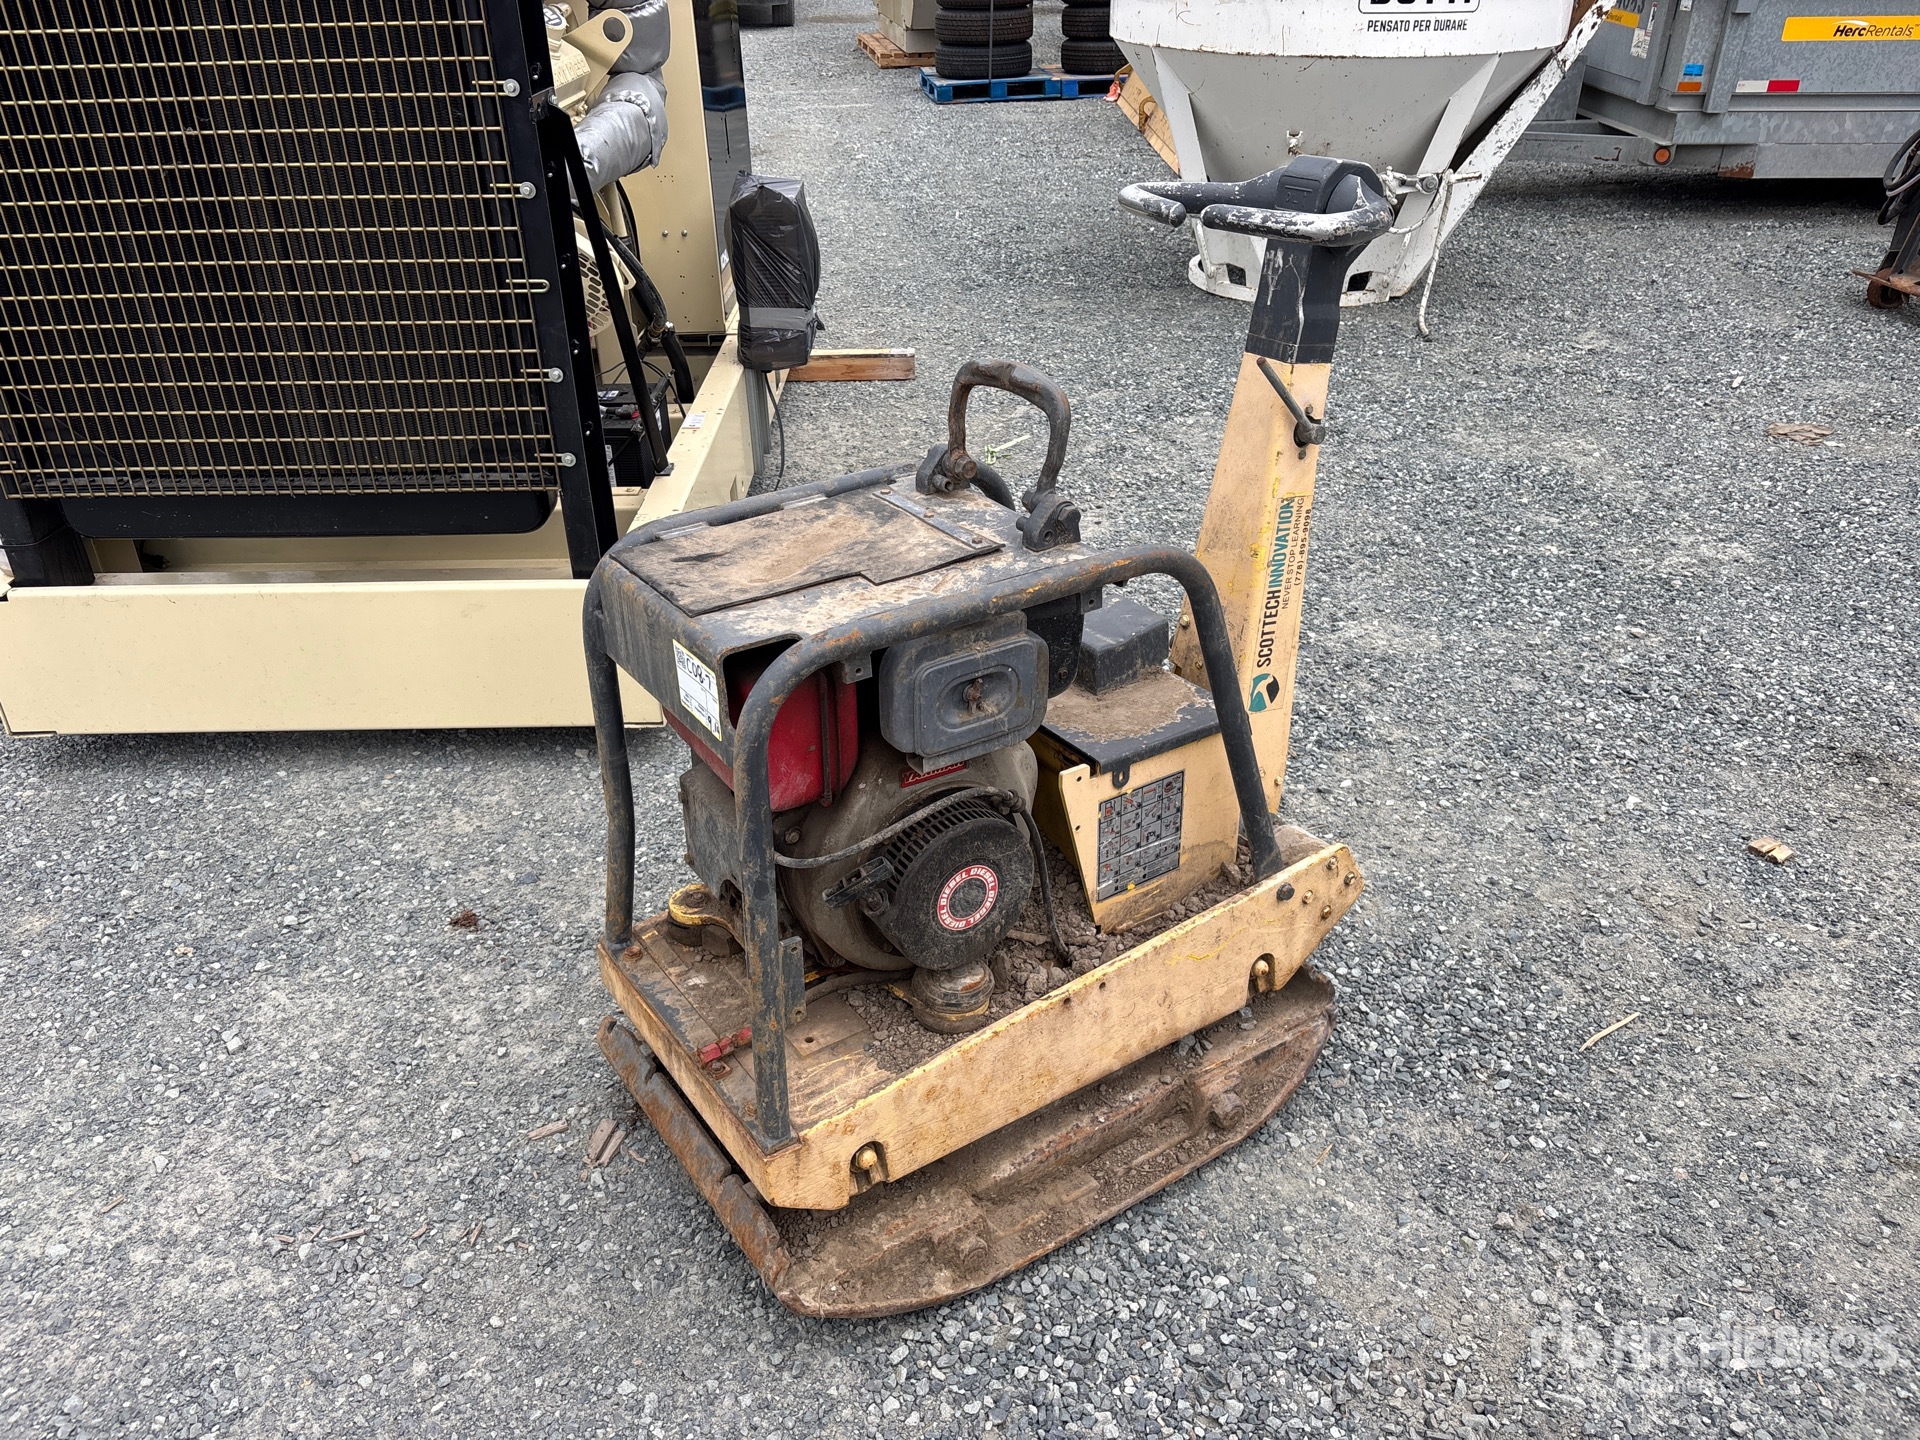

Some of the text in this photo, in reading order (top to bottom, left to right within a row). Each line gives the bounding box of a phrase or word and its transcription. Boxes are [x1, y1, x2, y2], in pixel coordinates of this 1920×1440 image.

[1367, 19, 1468, 32] PENSATO PER DURARE
[1833, 24, 1914, 38] HercRentals
[1282, 497, 1304, 609] NEVER STOP LEARNING
[941, 871, 968, 905] DIESEL
[970, 867, 996, 889] DIESEL
[940, 905, 967, 928] DIESEL
[967, 890, 995, 924] DIESEL
